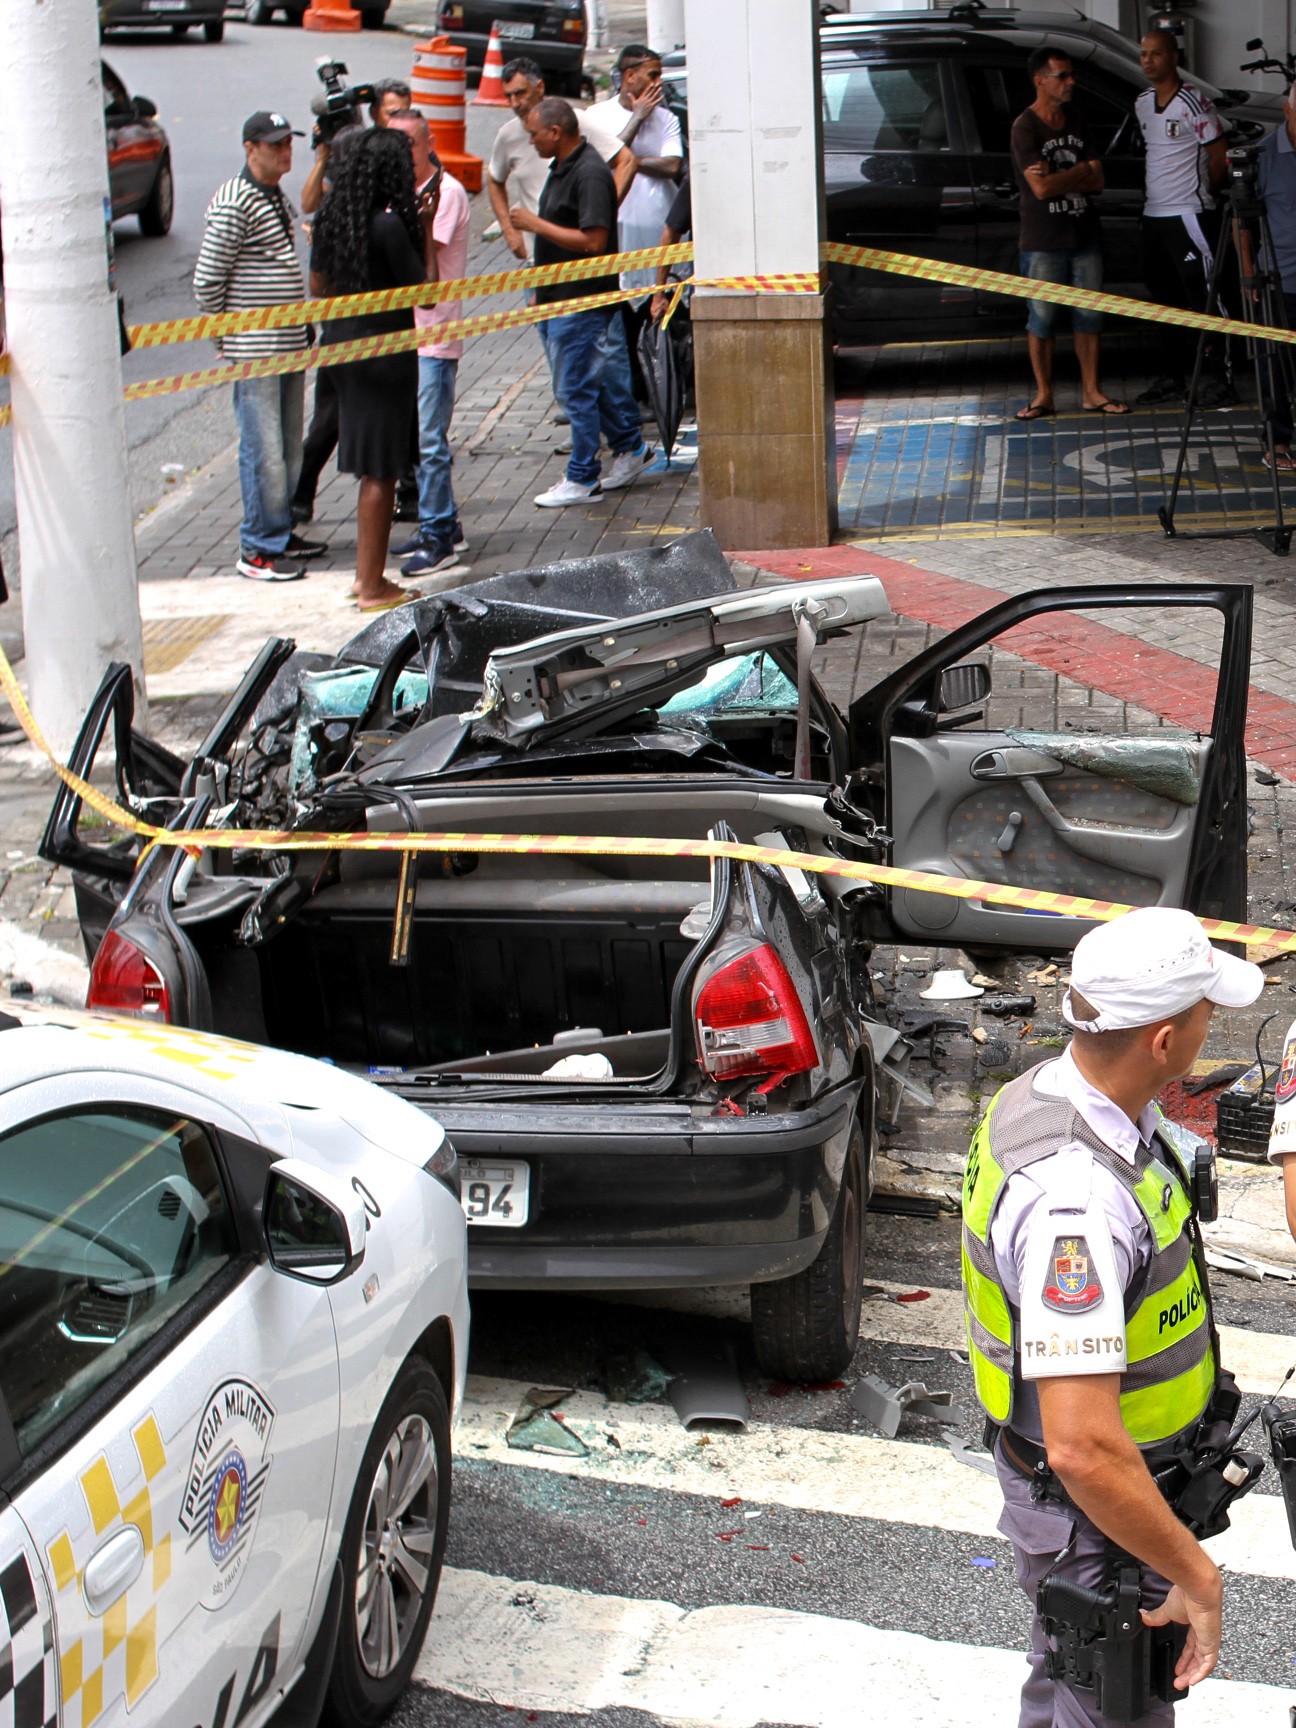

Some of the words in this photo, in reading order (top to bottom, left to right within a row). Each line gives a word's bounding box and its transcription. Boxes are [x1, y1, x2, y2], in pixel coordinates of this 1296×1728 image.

[467, 1181, 513, 1218] 94
[1024, 1331, 1124, 1358] TRÂNSITO
[185, 1404, 223, 1518] POLÍCIA
[224, 1388, 268, 1441] MILITAR
[212, 1580, 225, 1596] SÃO
[224, 1556, 242, 1591] PAULO
